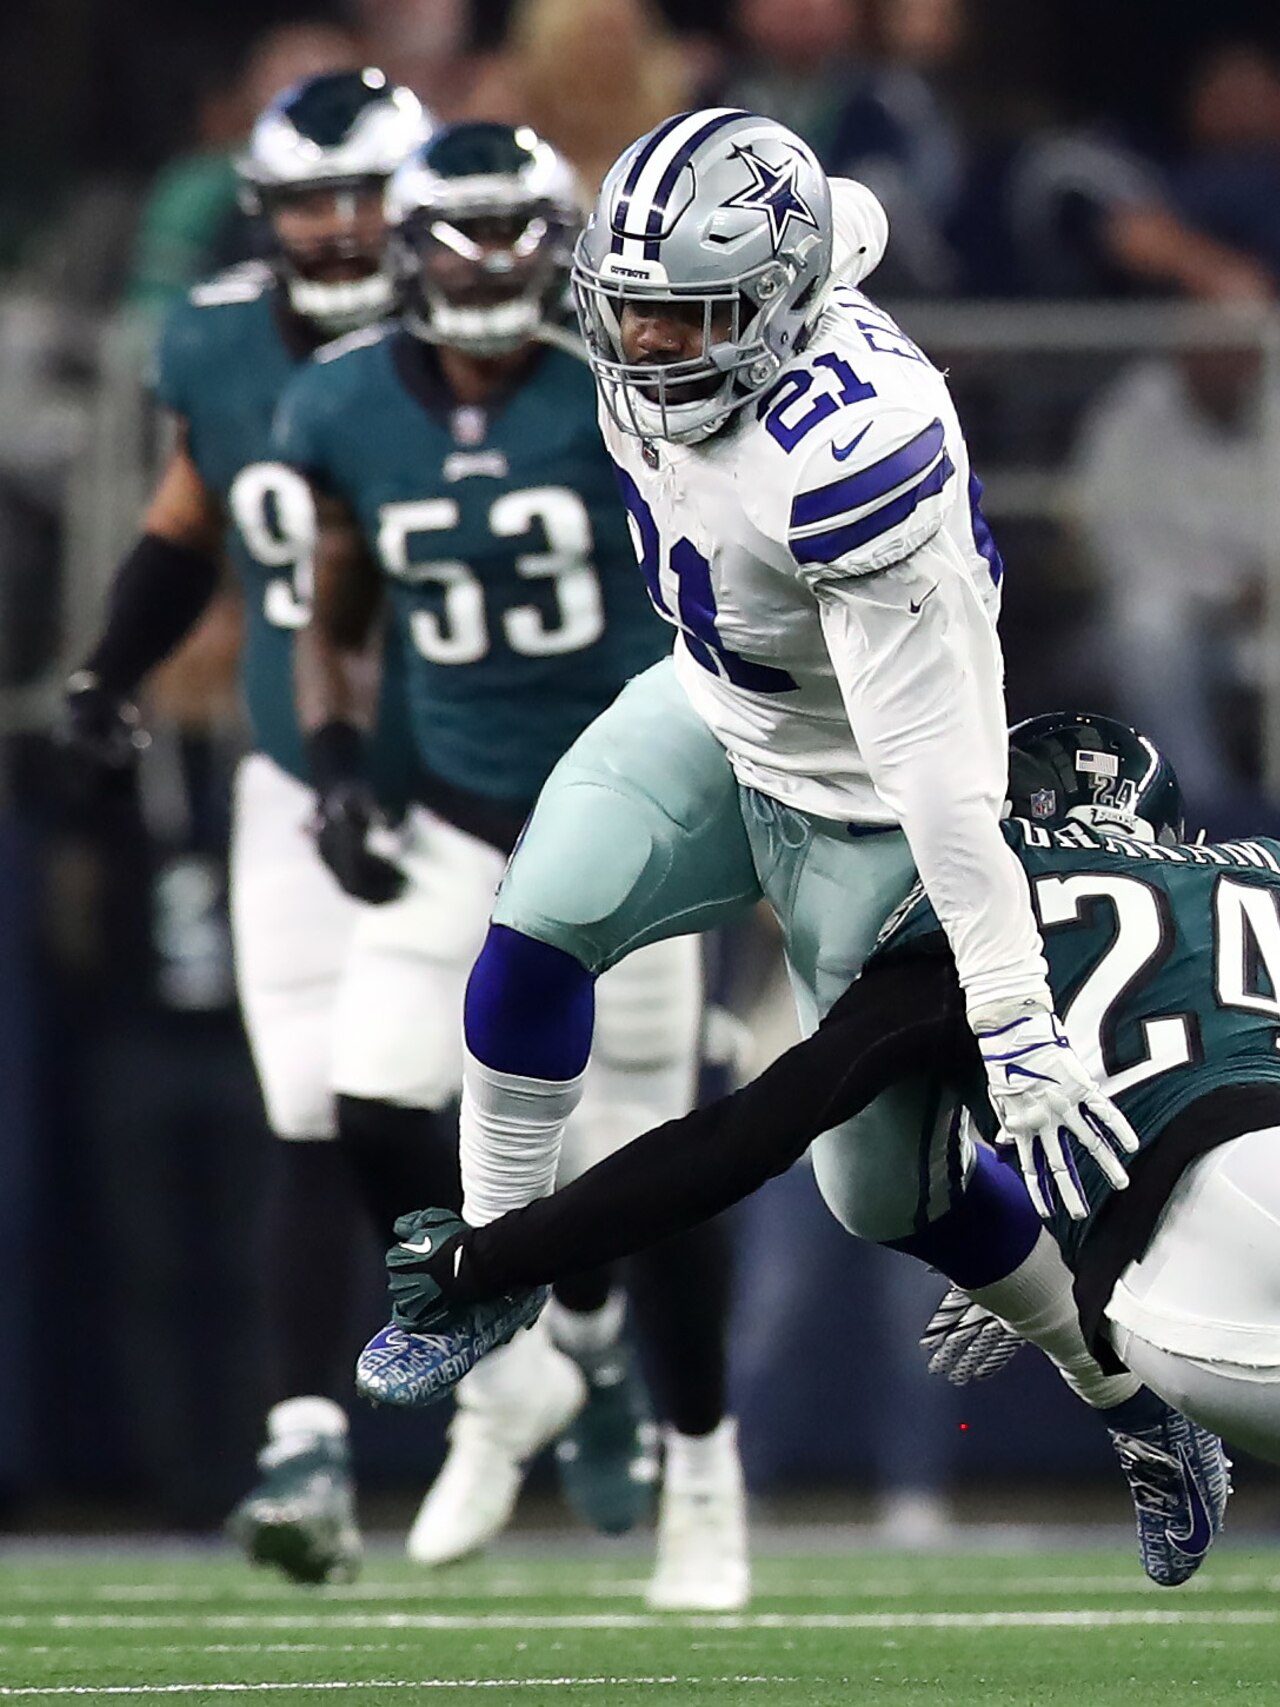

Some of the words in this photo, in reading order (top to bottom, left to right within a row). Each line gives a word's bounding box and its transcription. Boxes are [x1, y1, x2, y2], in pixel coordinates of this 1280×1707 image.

[757, 352, 877, 454] 21
[377, 486, 605, 665] 53
[1145, 1531, 1169, 1577] SPCA
